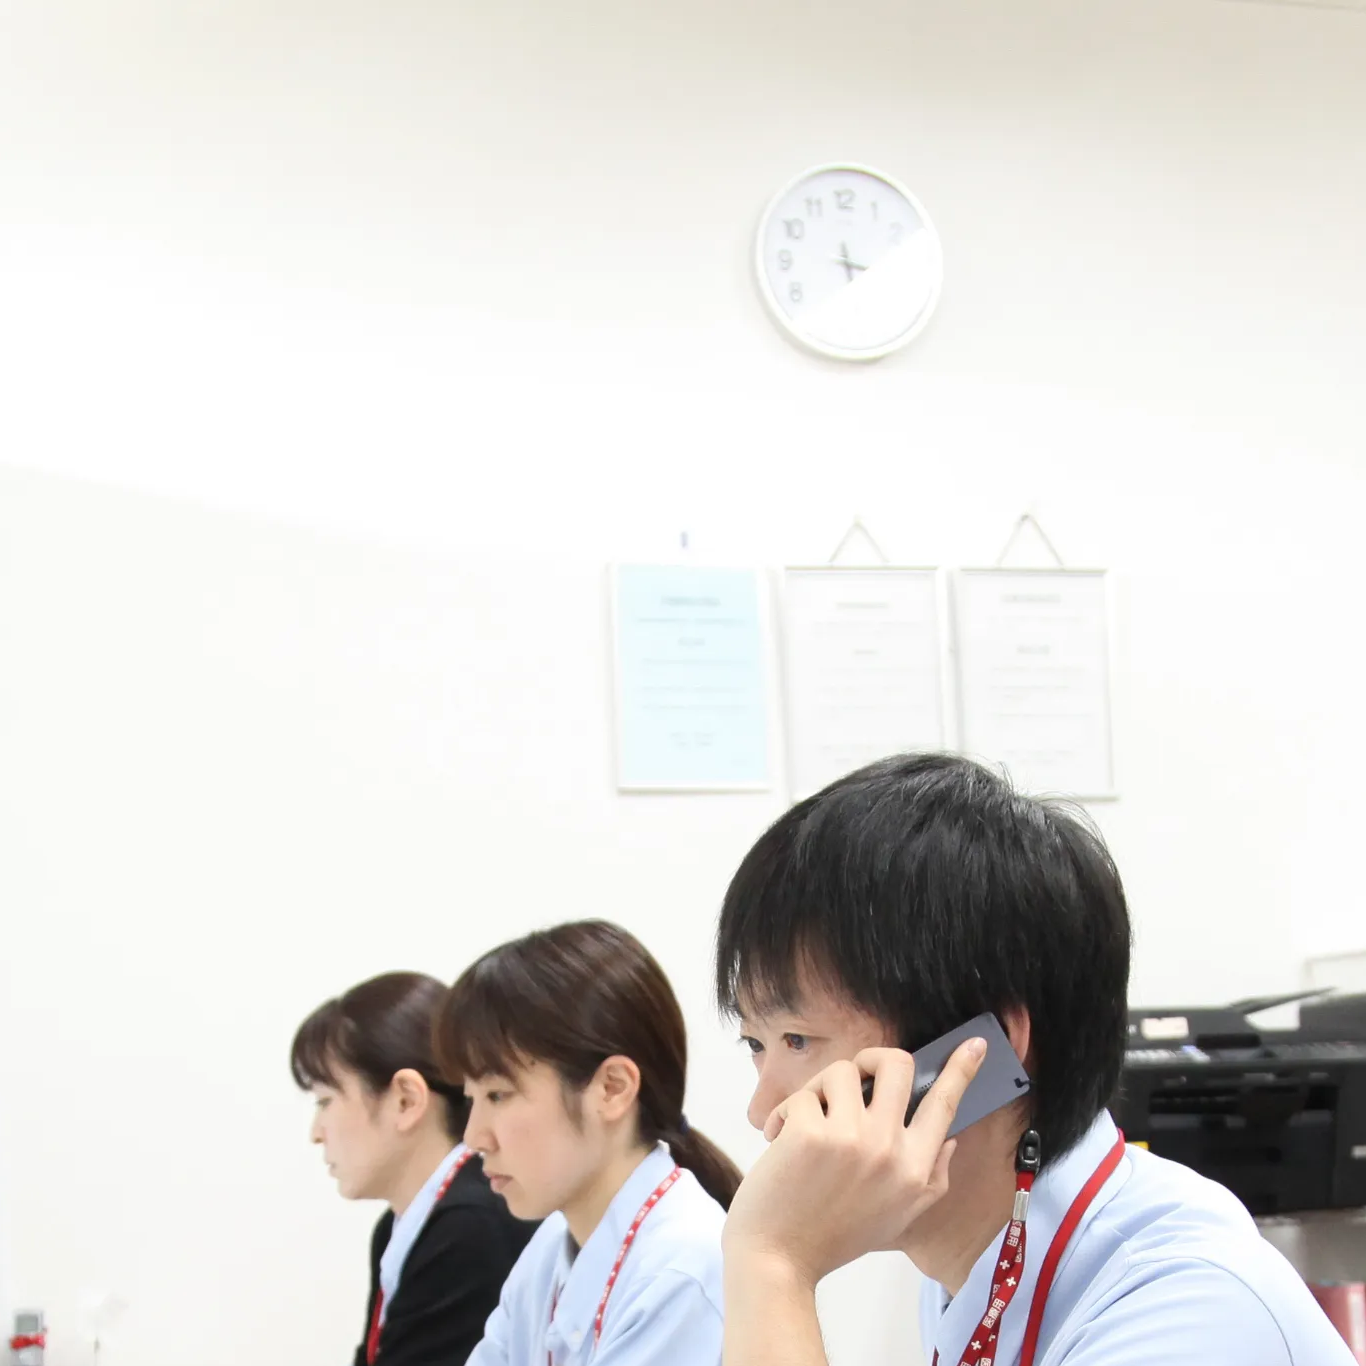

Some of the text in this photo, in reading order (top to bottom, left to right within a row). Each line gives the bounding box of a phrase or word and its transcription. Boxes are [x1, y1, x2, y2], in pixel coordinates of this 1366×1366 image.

[804, 196, 823, 217] 11
[833, 188, 856, 211] 12
[869, 201, 879, 221] 1
[782, 217, 805, 240] 10
[777, 249, 794, 271] 9
[788, 281, 804, 303] 8
